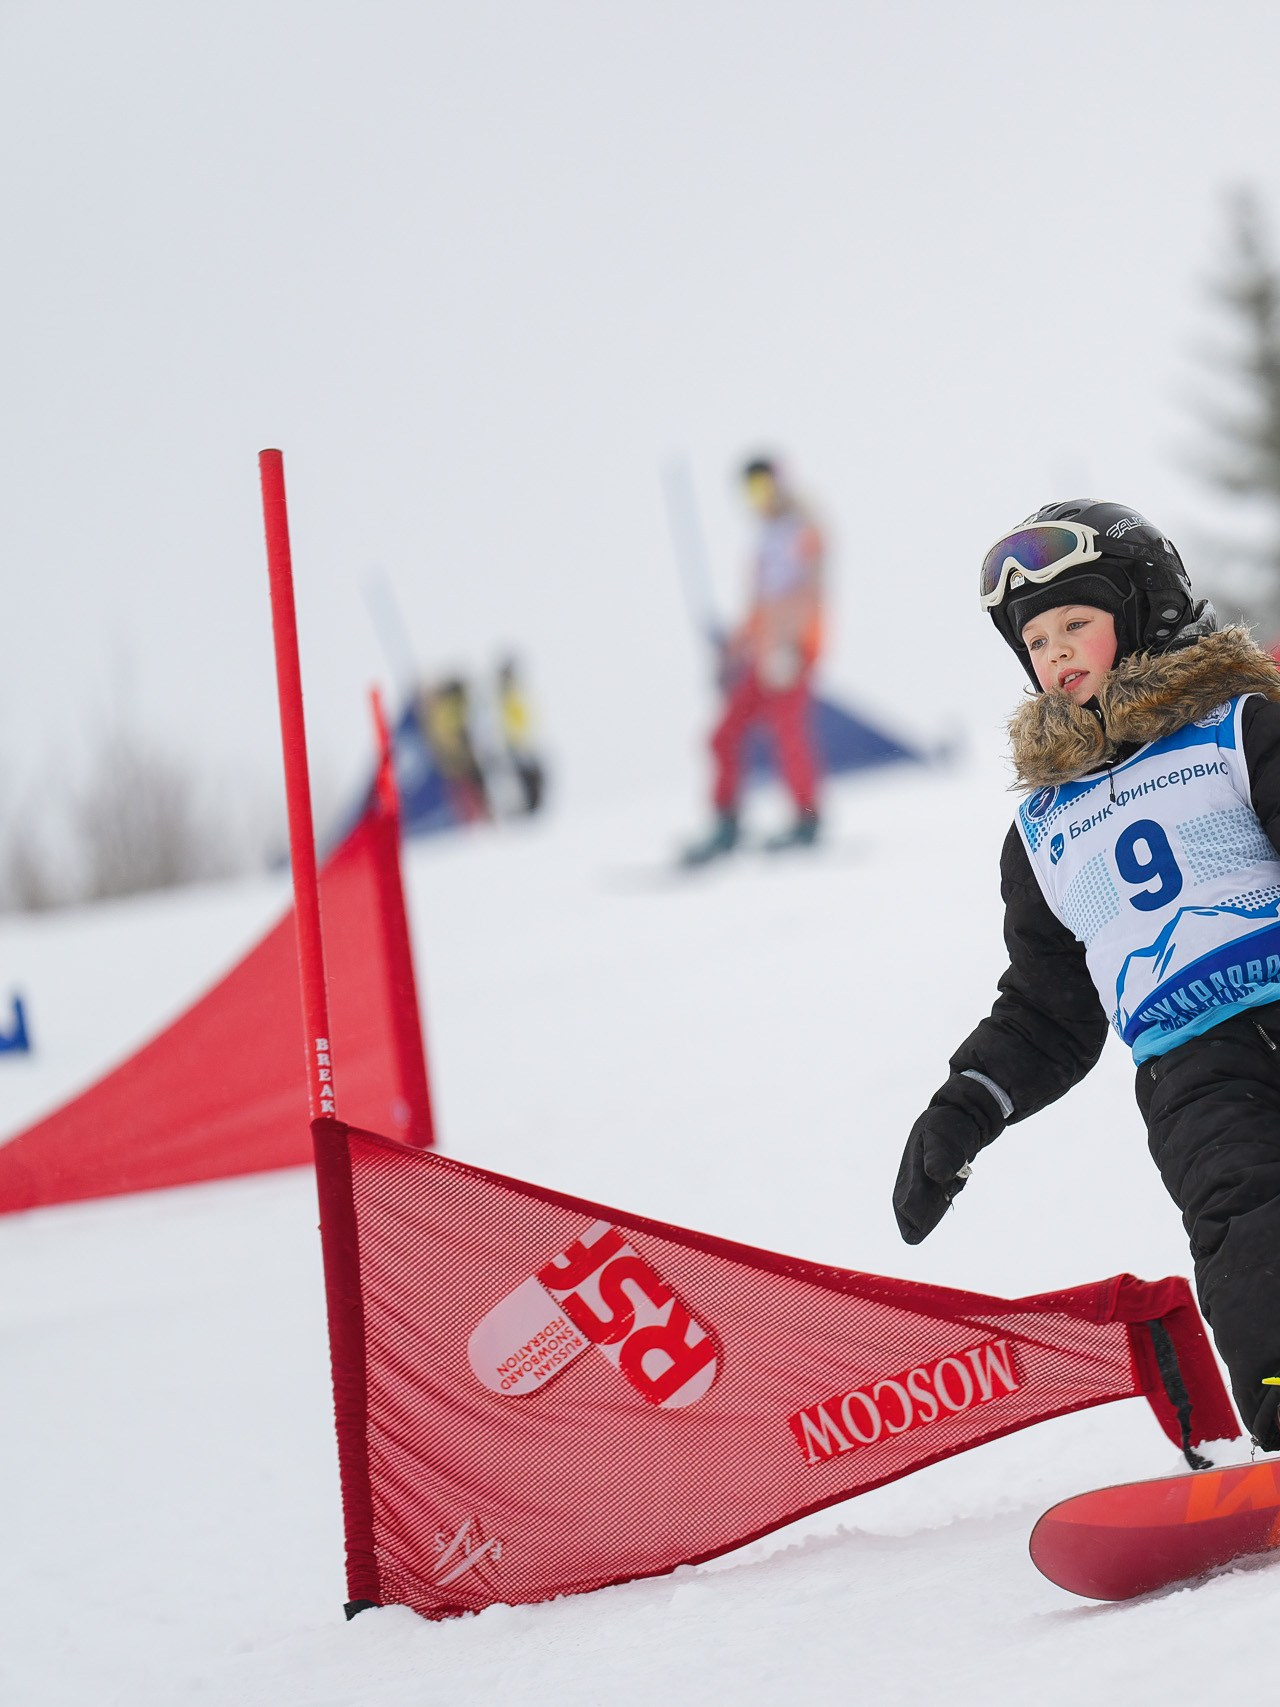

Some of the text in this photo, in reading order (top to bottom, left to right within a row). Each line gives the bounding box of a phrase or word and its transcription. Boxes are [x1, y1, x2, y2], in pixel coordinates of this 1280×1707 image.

[1068, 803, 1114, 840] Банк
[1114, 819, 1183, 912] 9
[315, 1038, 335, 1115] BREAK
[496, 1316, 566, 1377] FEDERATION
[538, 1227, 718, 1407] RSF
[500, 1326, 575, 1390] SNOWBOARD
[533, 1336, 583, 1381] RUSSIAN
[799, 1340, 1021, 1465] MOSCOW
